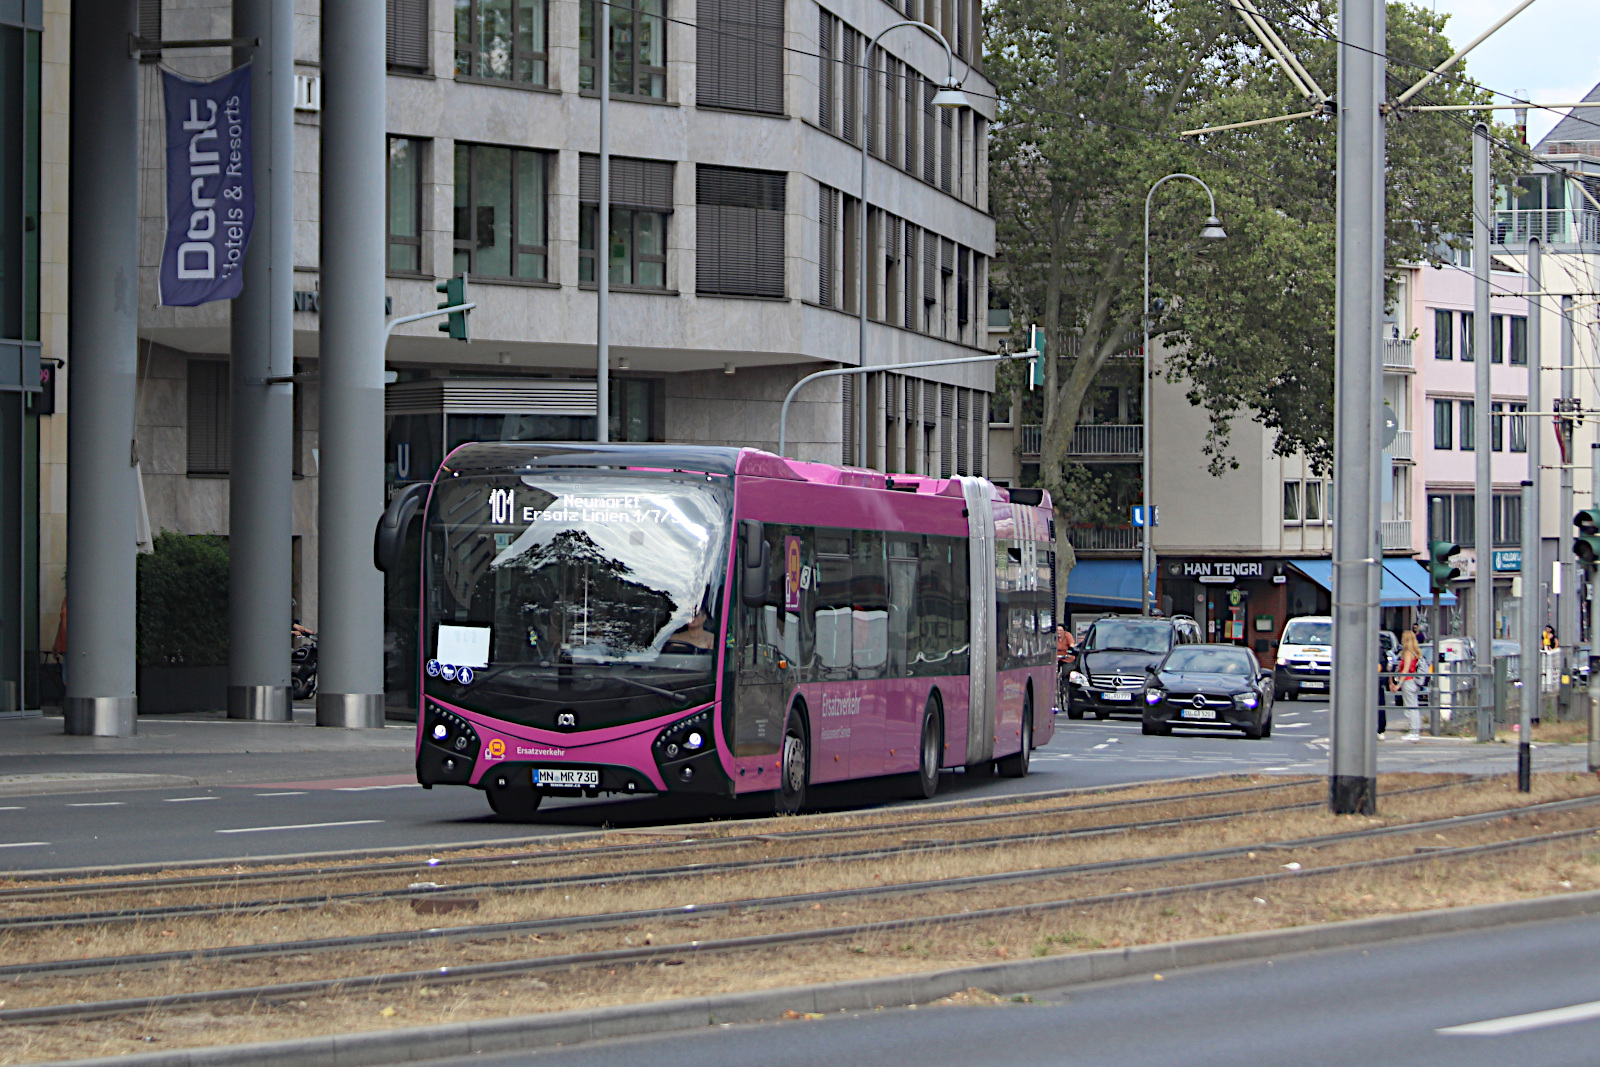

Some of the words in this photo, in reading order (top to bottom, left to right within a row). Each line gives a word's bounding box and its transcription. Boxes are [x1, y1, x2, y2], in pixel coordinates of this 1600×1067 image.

[223, 95, 242, 176] Resorts
[177, 98, 220, 279] Dorint
[223, 186, 242, 201] &
[397, 443, 409, 478] U
[488, 488, 515, 524] 101
[563, 494, 641, 509] Neumarkt
[523, 506, 579, 522] Ersatz
[582, 508, 630, 523] Linien
[1183, 562, 1211, 576] HAN
[1214, 562, 1263, 576] TENGRI
[822, 689, 861, 717] Ersatzverkehr
[516, 746, 565, 756] Ersatzverkehr
[539, 771, 554, 782] MN
[560, 771, 575, 783] MR
[576, 771, 597, 783] 730
